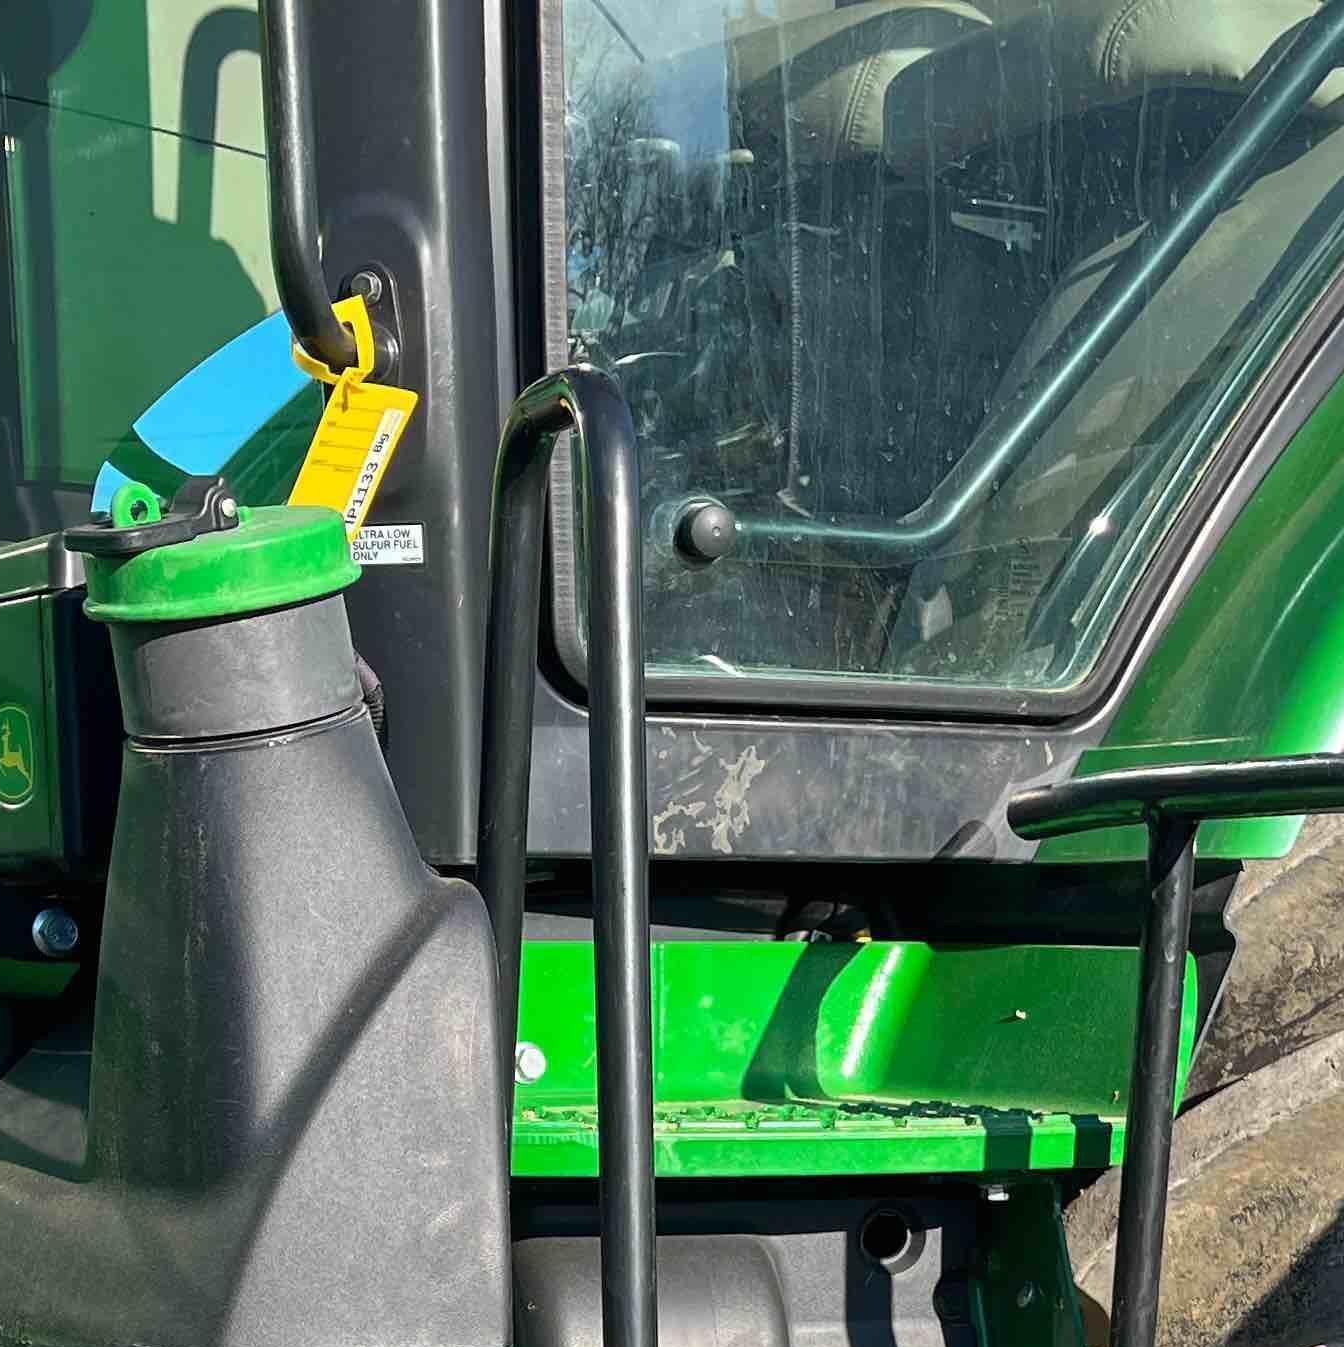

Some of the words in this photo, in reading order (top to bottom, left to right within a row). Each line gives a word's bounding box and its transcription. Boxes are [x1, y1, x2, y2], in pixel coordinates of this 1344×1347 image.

[356, 529, 384, 540] LTRA
[387, 529, 410, 539] LOW
[353, 540, 391, 551] SULFUR
[394, 539, 419, 550] FUEL
[353, 551, 378, 561] ONLY
